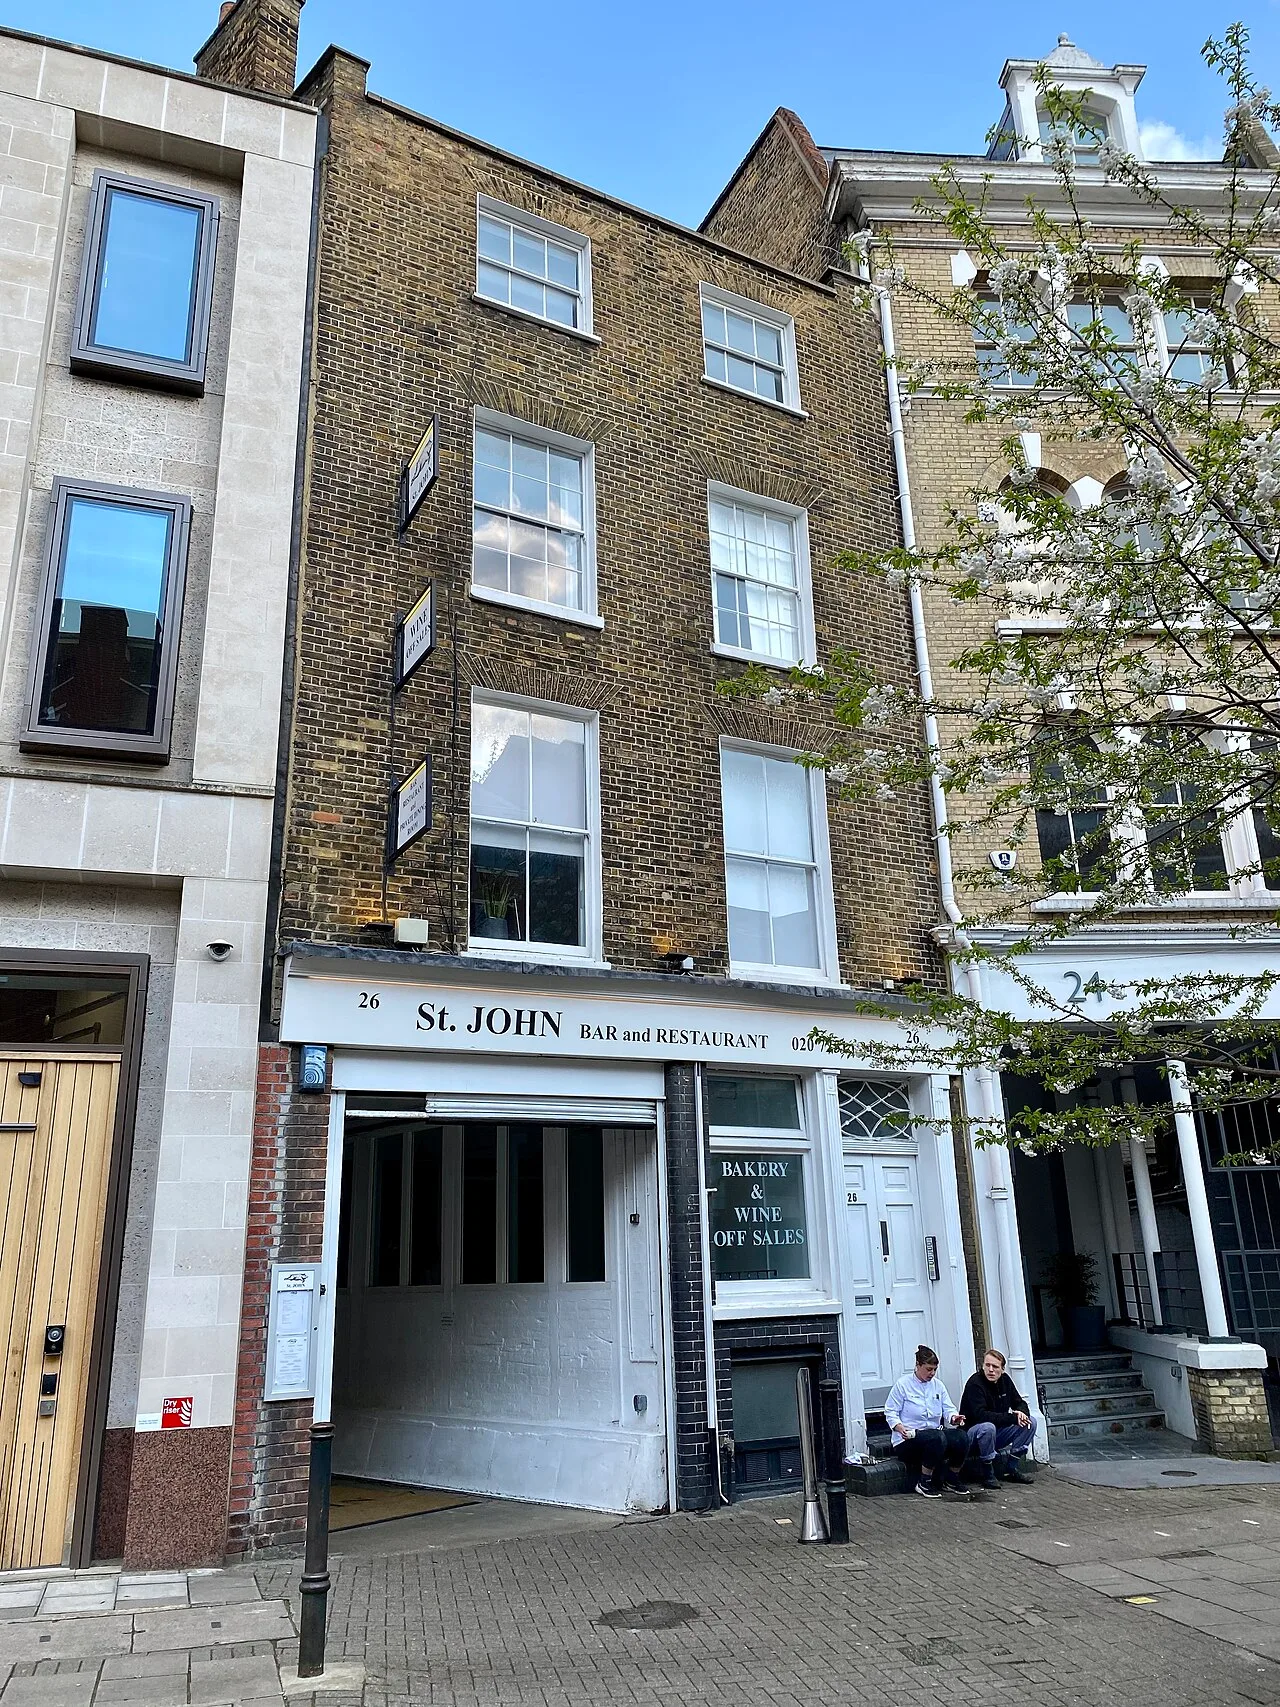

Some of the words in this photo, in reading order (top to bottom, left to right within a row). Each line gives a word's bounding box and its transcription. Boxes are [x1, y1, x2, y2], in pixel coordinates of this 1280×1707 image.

[410, 608, 428, 638] WINE
[406, 642, 416, 659] OFF
[415, 624, 431, 648] SALES
[402, 782, 424, 807] RESTAURANT
[1063, 971, 1103, 1003] 24
[358, 992, 380, 1010] 26
[416, 1002, 457, 1033] St.
[467, 1006, 563, 1038] JOHN
[580, 1024, 618, 1042] BAR
[622, 1028, 651, 1043] and
[656, 1029, 769, 1049] RESTAURANT
[791, 1036, 814, 1052] 020
[906, 1030, 920, 1044] 26
[722, 1161, 789, 1177] BAKERY
[751, 1184, 764, 1200] &
[847, 1193, 858, 1203] 26
[734, 1207, 783, 1222] WINE
[713, 1230, 747, 1247] OFF
[753, 1229, 804, 1246] SALES
[164, 1400, 177, 1408] Dry
